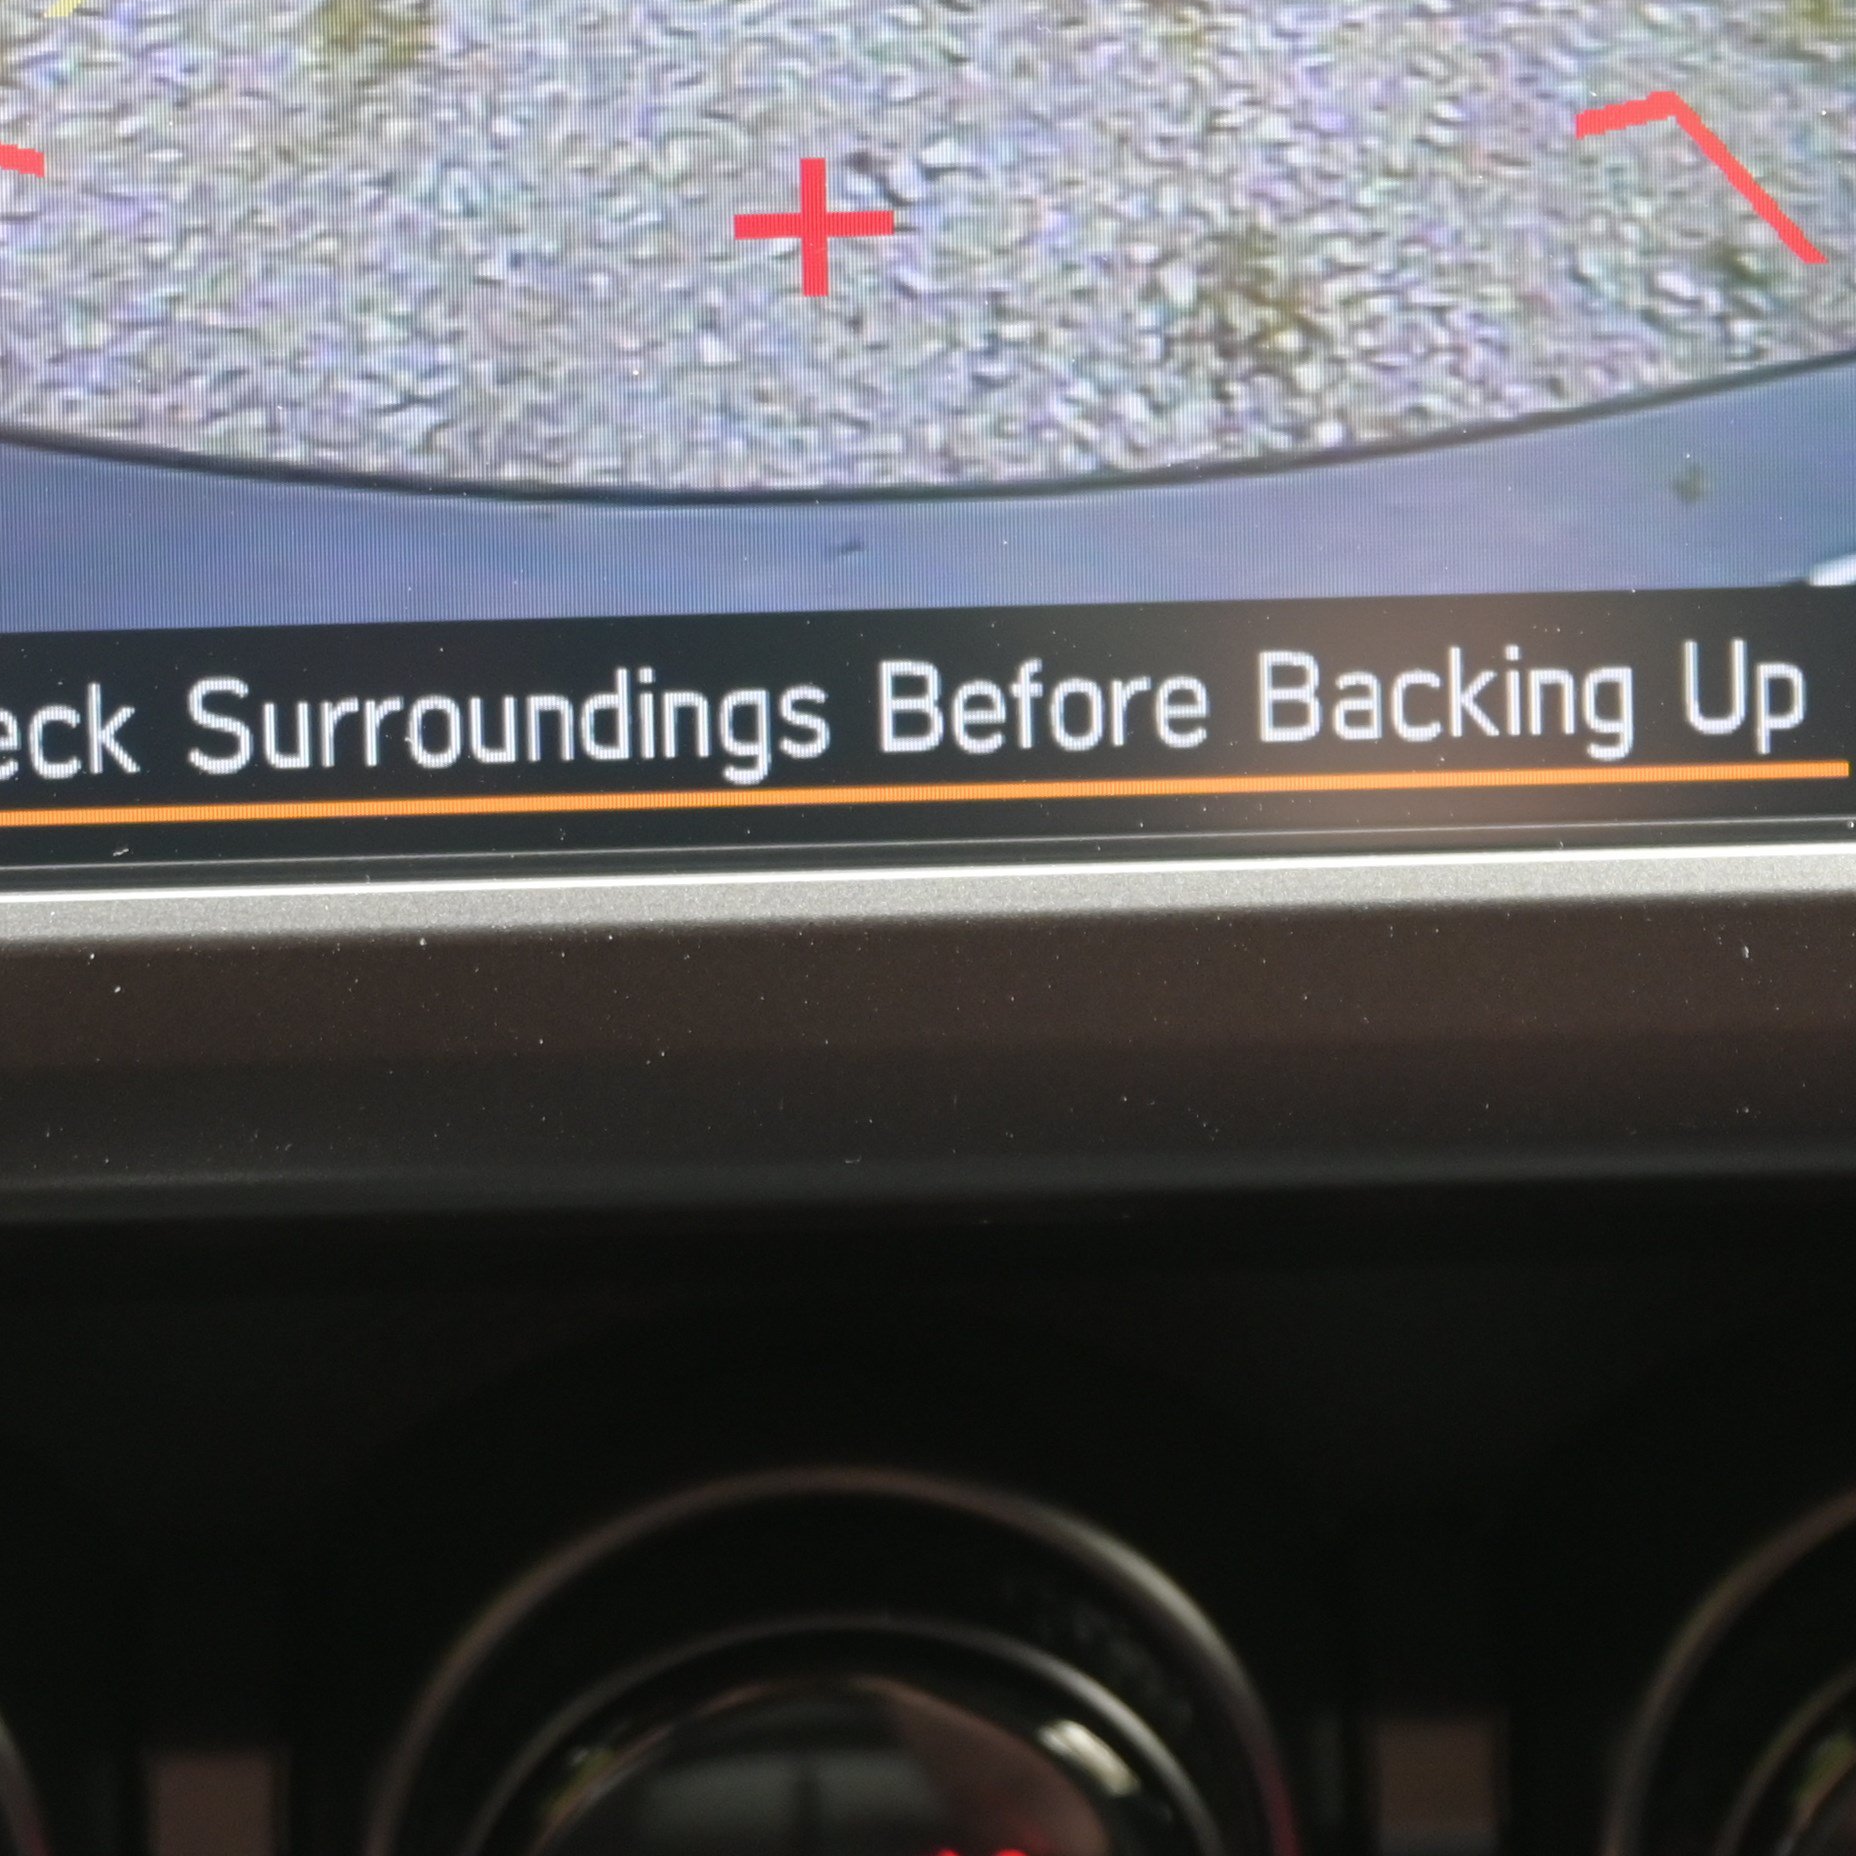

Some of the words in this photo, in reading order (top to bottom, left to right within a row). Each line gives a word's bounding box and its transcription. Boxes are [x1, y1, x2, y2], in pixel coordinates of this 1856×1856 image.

[187, 666, 831, 786] Surroundings
[878, 656, 1212, 755] Before
[1255, 642, 1637, 764] Backing
[1681, 636, 1807, 756] Up
